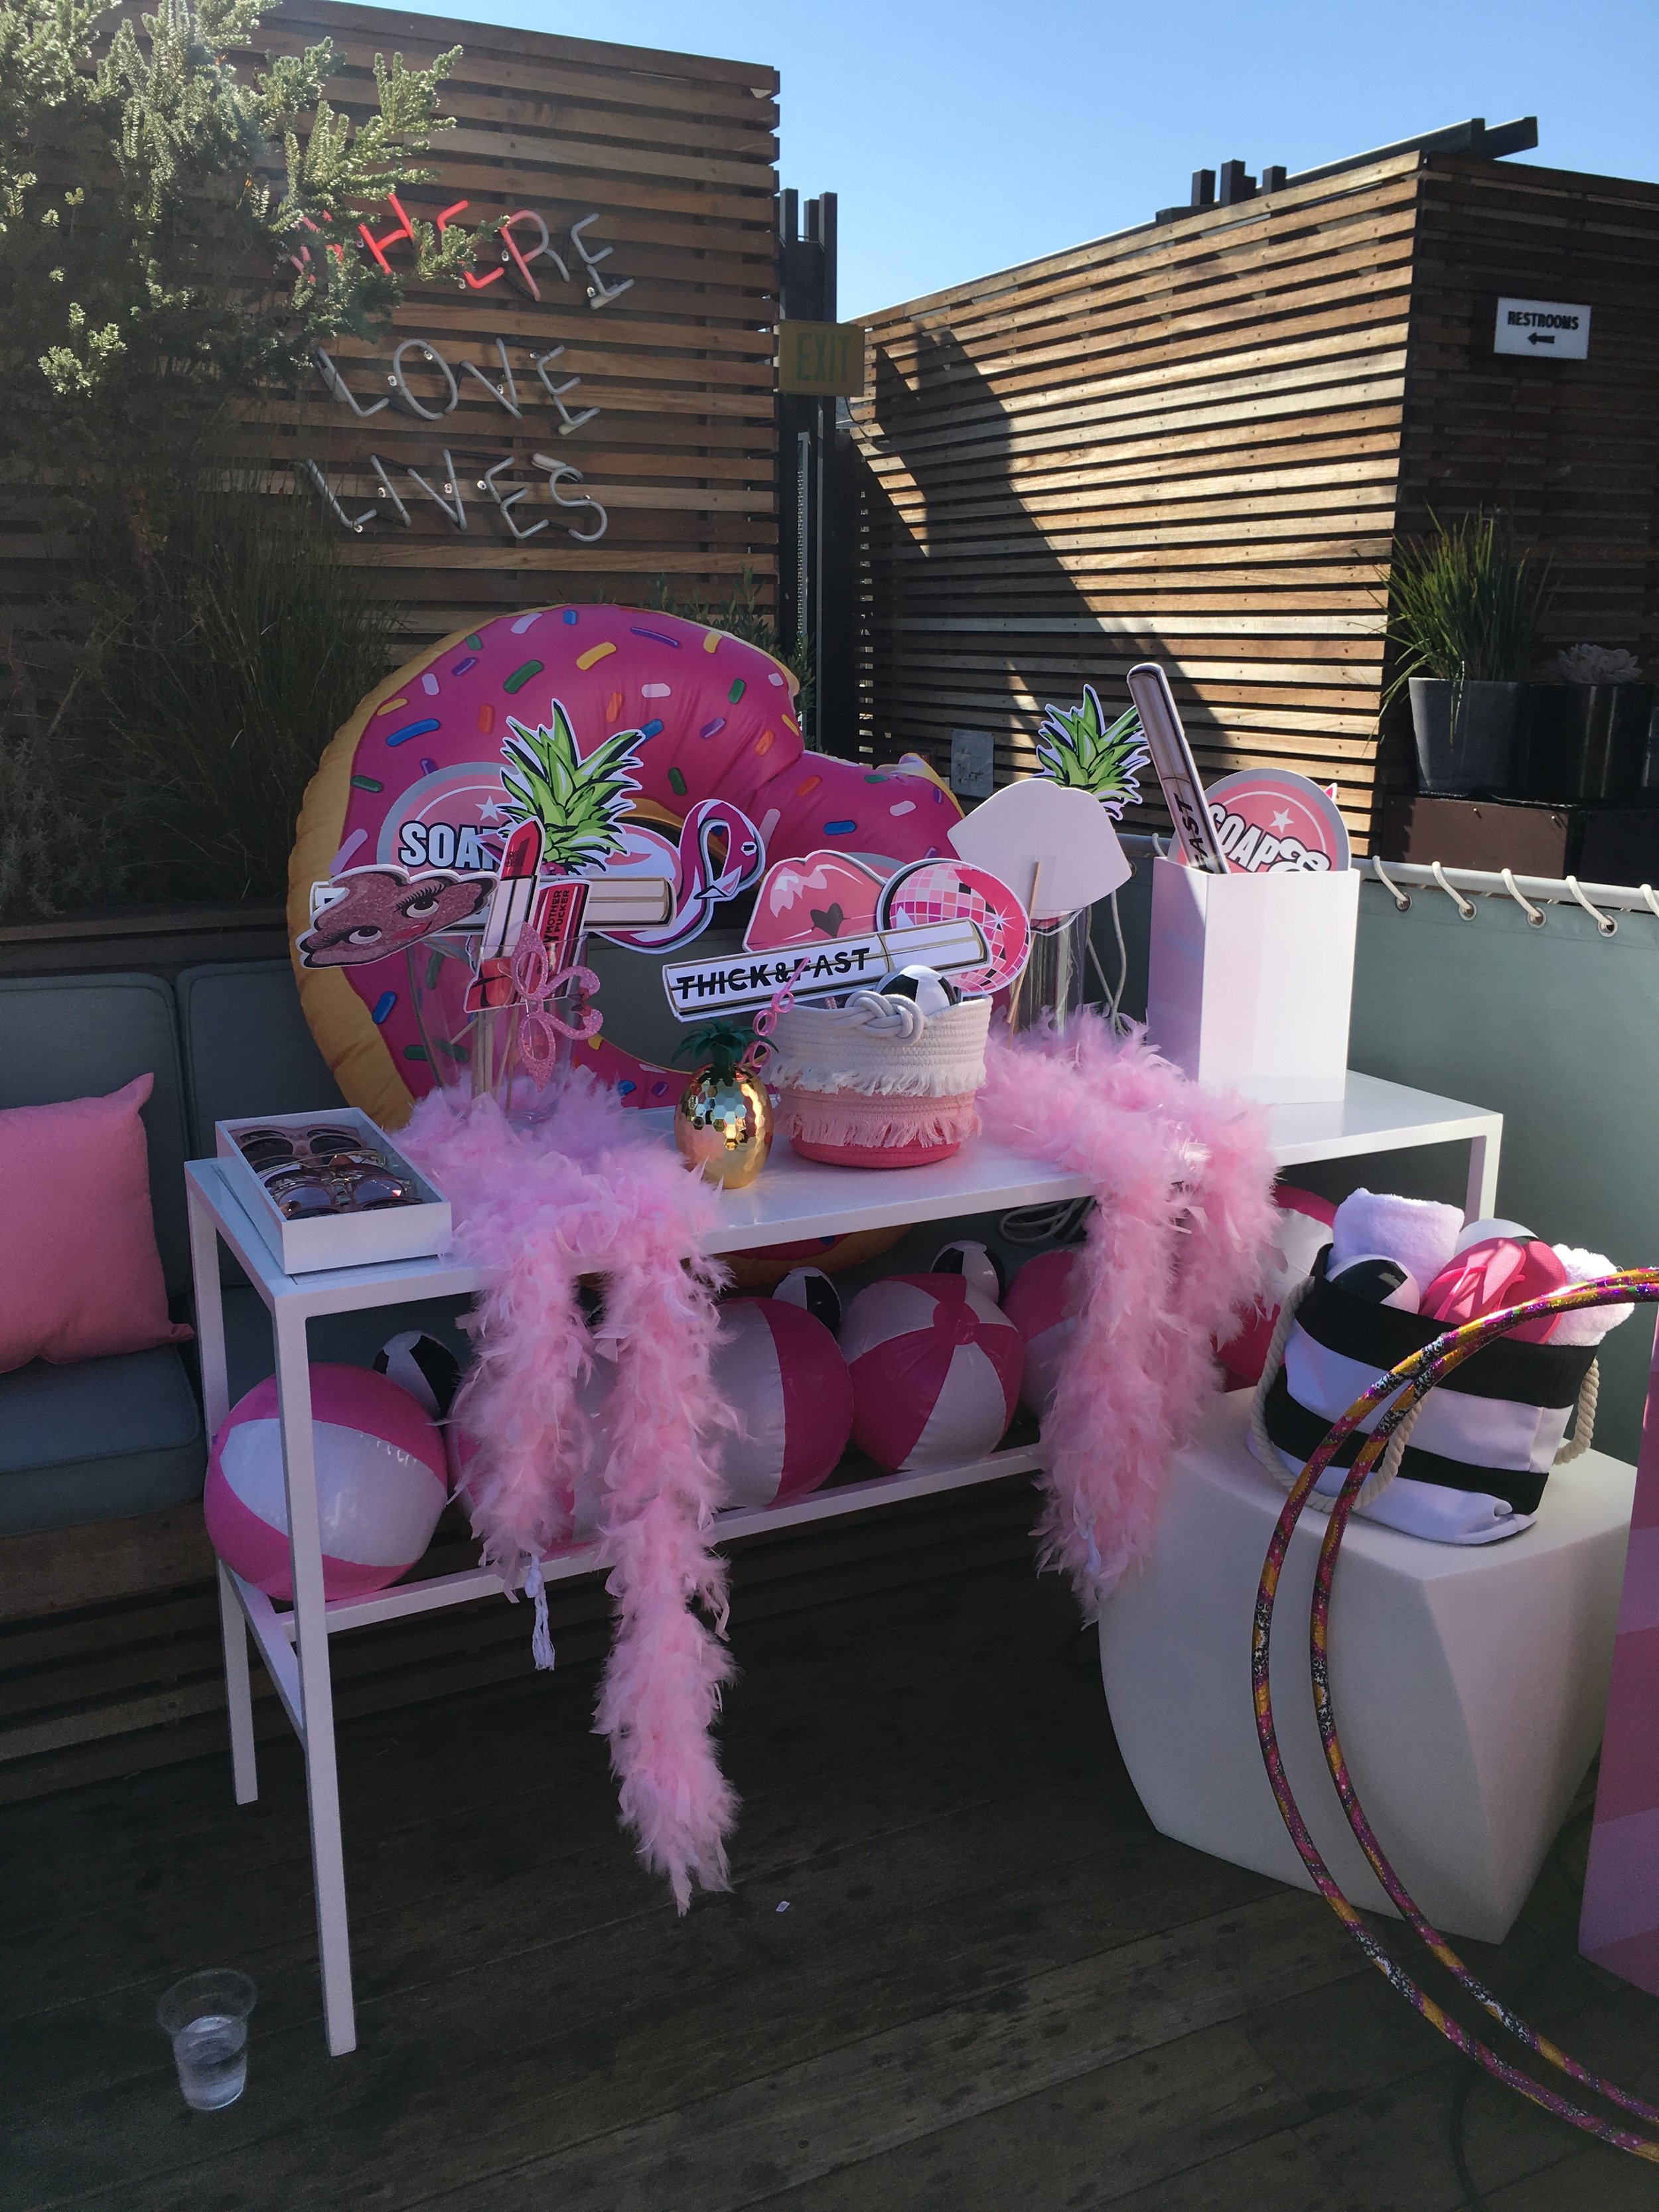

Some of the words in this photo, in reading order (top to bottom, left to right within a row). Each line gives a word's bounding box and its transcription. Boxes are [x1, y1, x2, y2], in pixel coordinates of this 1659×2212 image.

[1507, 311, 1579, 331] RESTROOMS
[796, 332, 851, 383] EXIT
[316, 337, 601, 435] LOVE
[304, 449, 609, 542] LIVES
[544, 890, 562, 934] MOTHER
[553, 890, 569, 932] PUCKER
